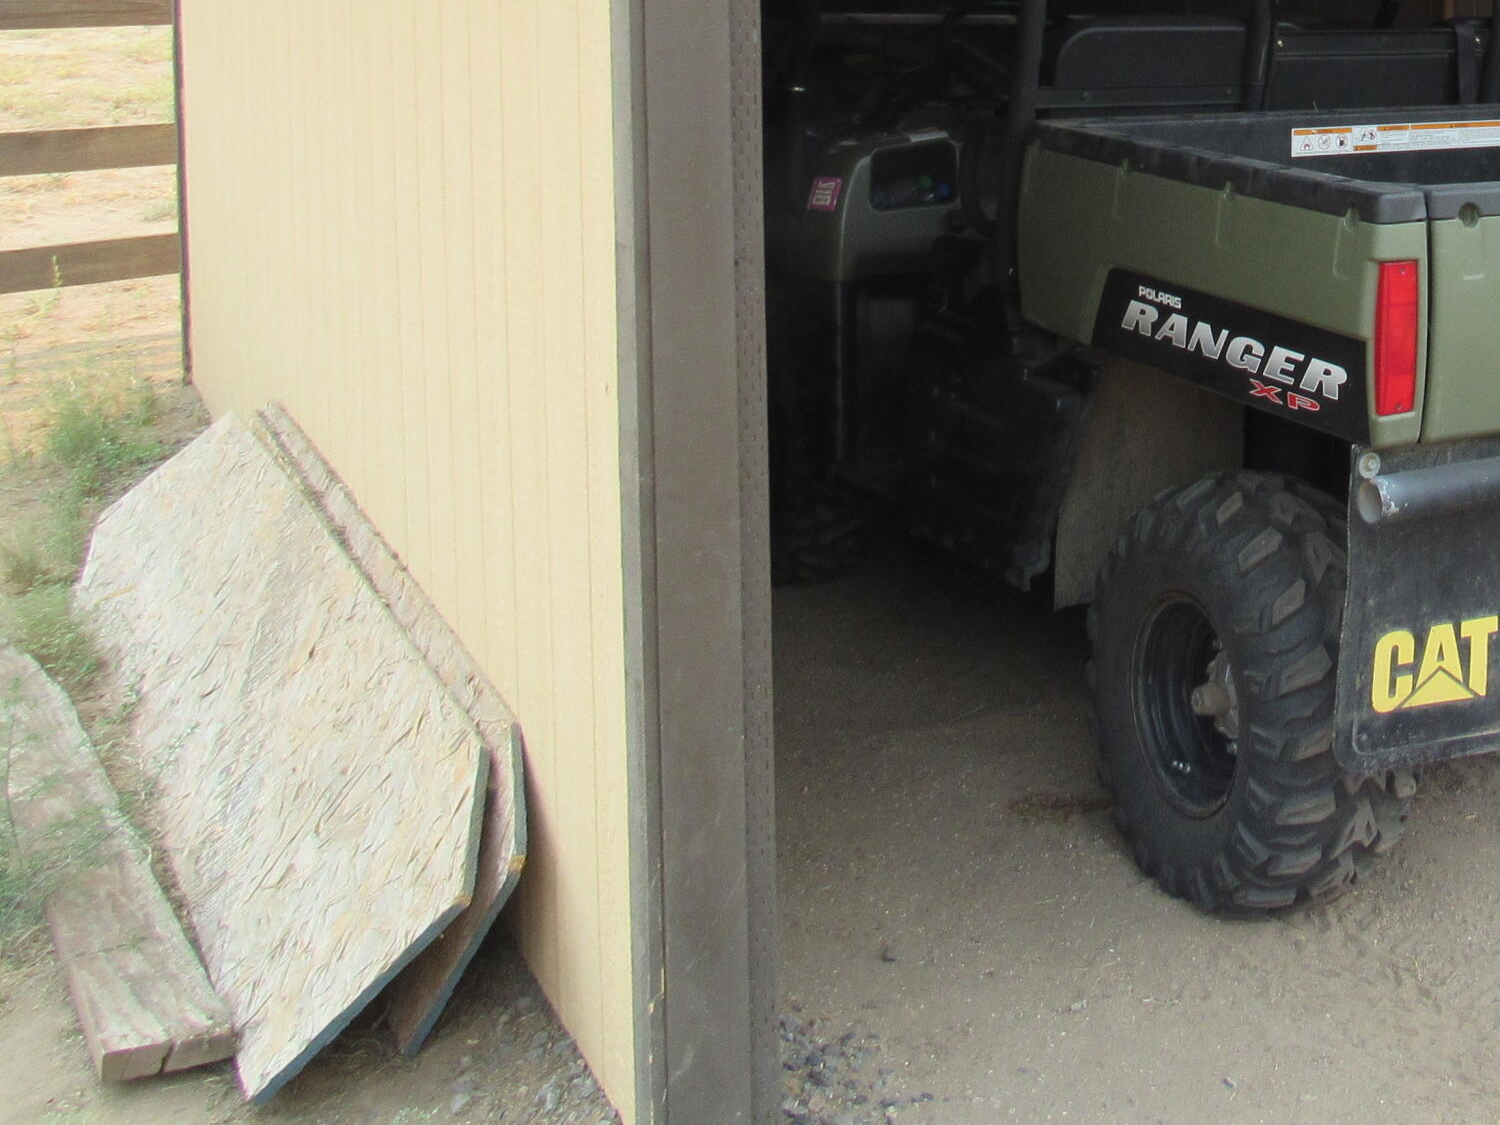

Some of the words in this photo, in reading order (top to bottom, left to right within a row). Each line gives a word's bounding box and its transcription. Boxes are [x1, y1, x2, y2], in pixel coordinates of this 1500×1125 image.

[1138, 285, 1182, 309] POLARIS
[1120, 299, 1348, 401] RANGER
[1249, 377, 1321, 412] XP
